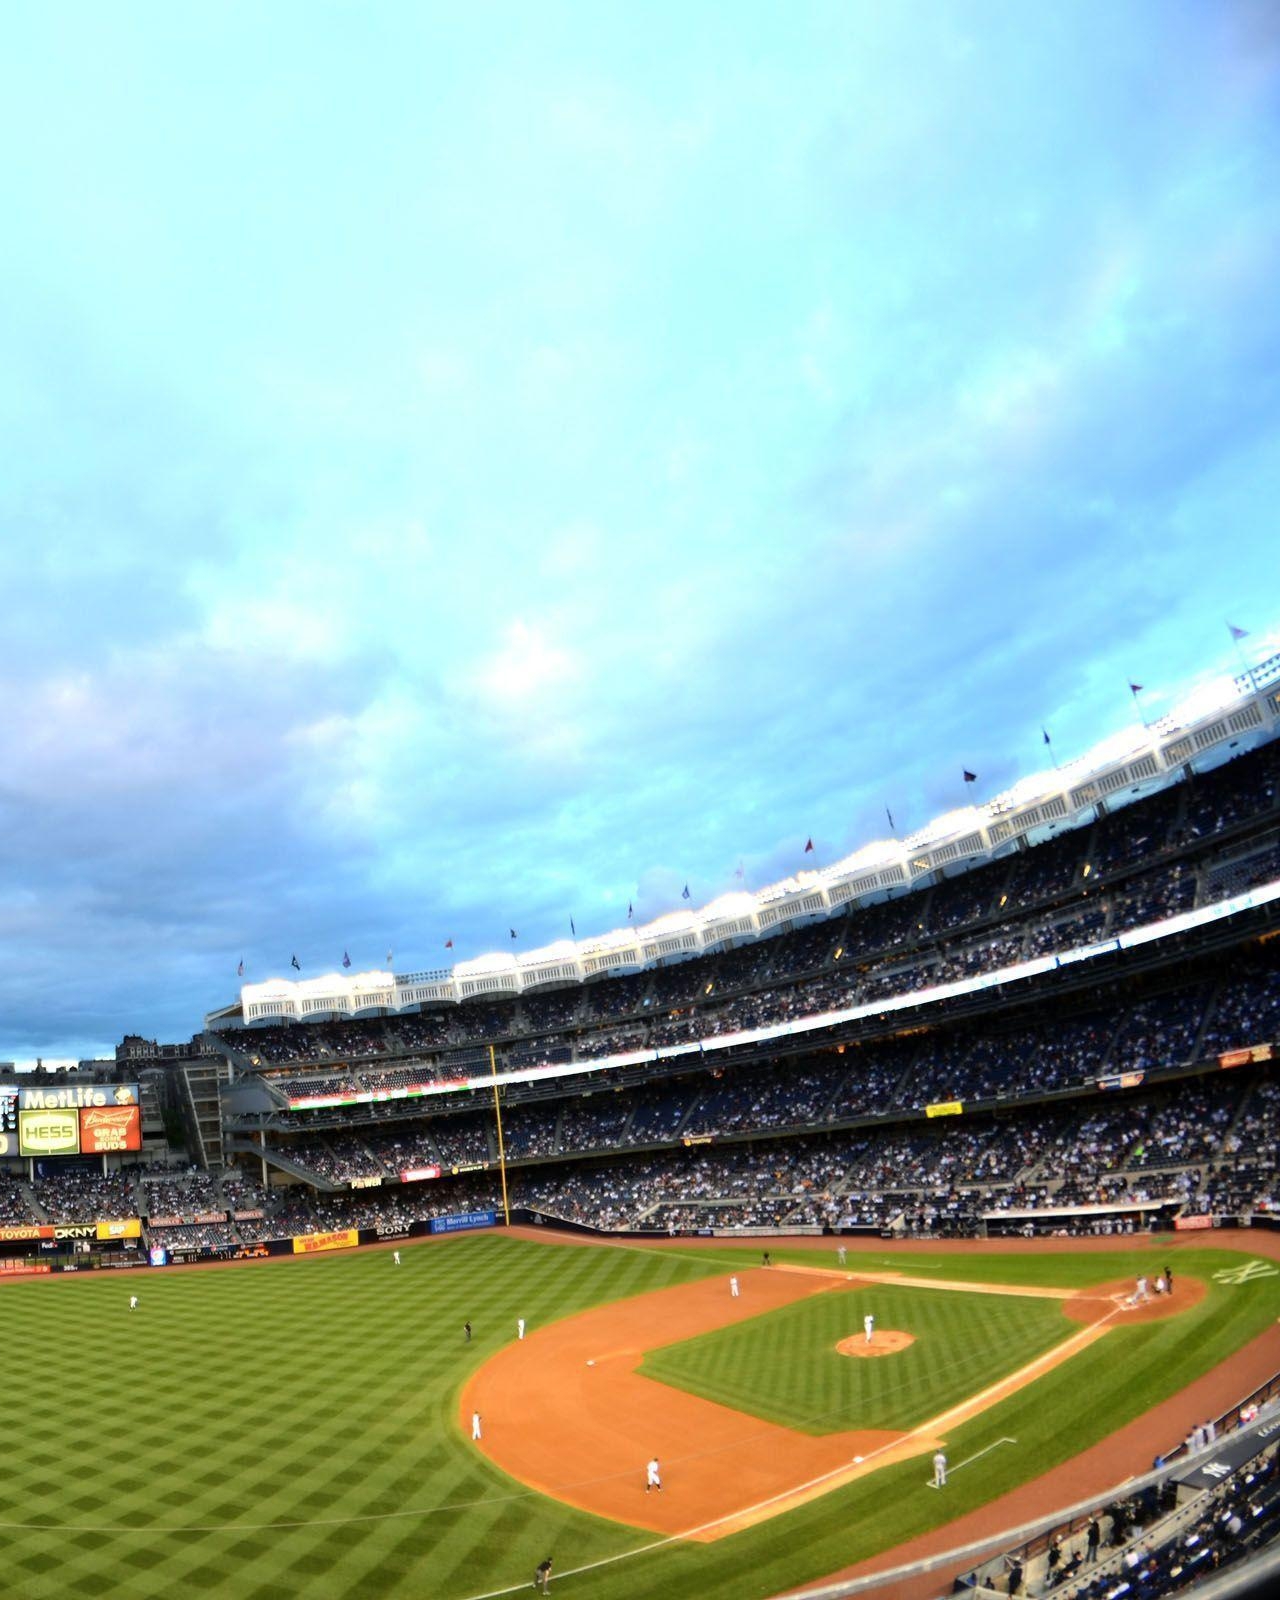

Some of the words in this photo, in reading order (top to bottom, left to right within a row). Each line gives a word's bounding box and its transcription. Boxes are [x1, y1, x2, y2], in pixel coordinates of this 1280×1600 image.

[24, 1087, 107, 1109] MetLife
[26, 1125, 74, 1139] HESS
[446, 1216, 467, 1226] Merrill
[469, 1213, 489, 1225] Lynch
[0, 1229, 41, 1240] TOYOTA
[55, 1227, 97, 1239] DKNY
[376, 1224, 412, 1236] SONY
